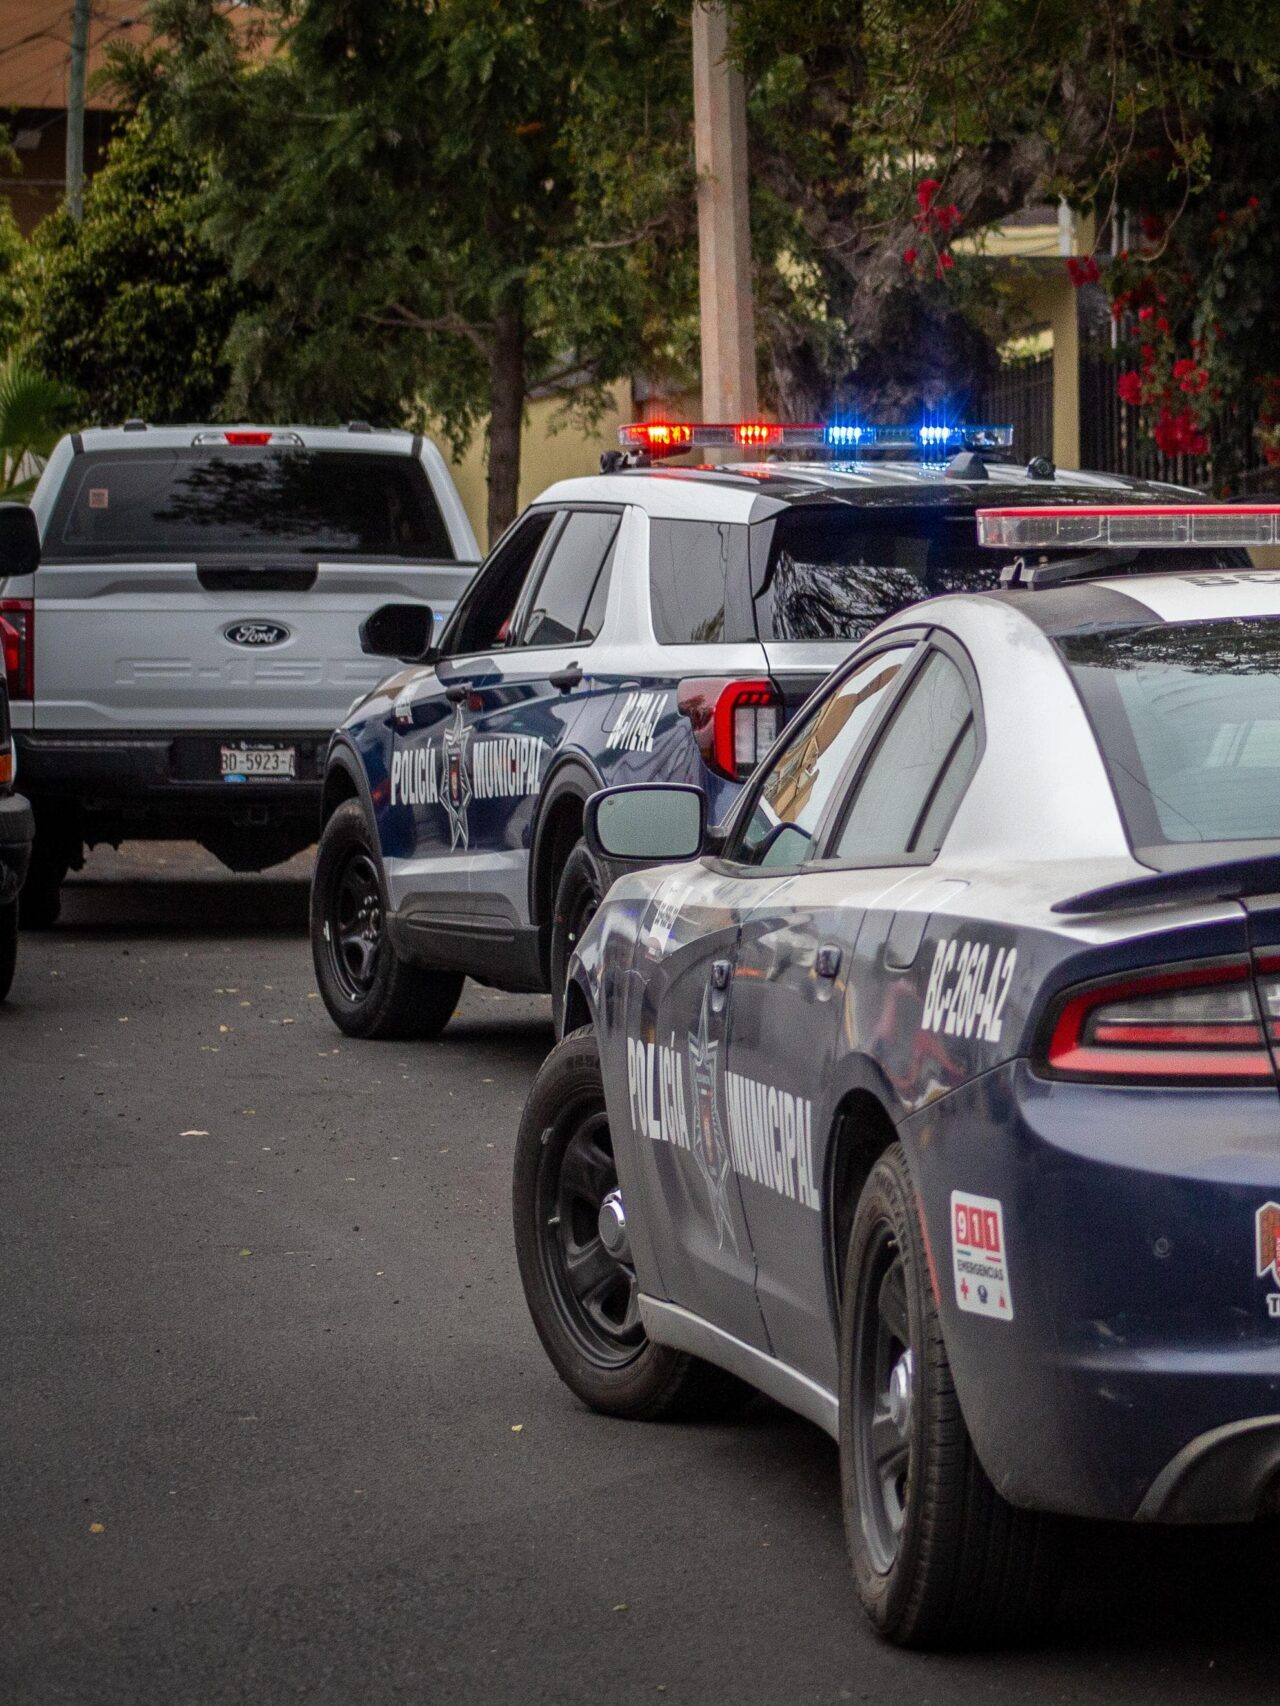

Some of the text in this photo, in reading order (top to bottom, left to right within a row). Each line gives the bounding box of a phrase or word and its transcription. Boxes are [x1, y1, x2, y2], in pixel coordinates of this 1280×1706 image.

[236, 625, 278, 643] Ford
[390, 737, 543, 806] POLICÍA MUNICIPAL
[921, 939, 1018, 1043] BC-260-A2
[627, 1030, 821, 1212] POLICÍA MUNICIPAL
[957, 1210, 996, 1247] 911
[957, 1259, 1004, 1280] EMERGENCIAS
